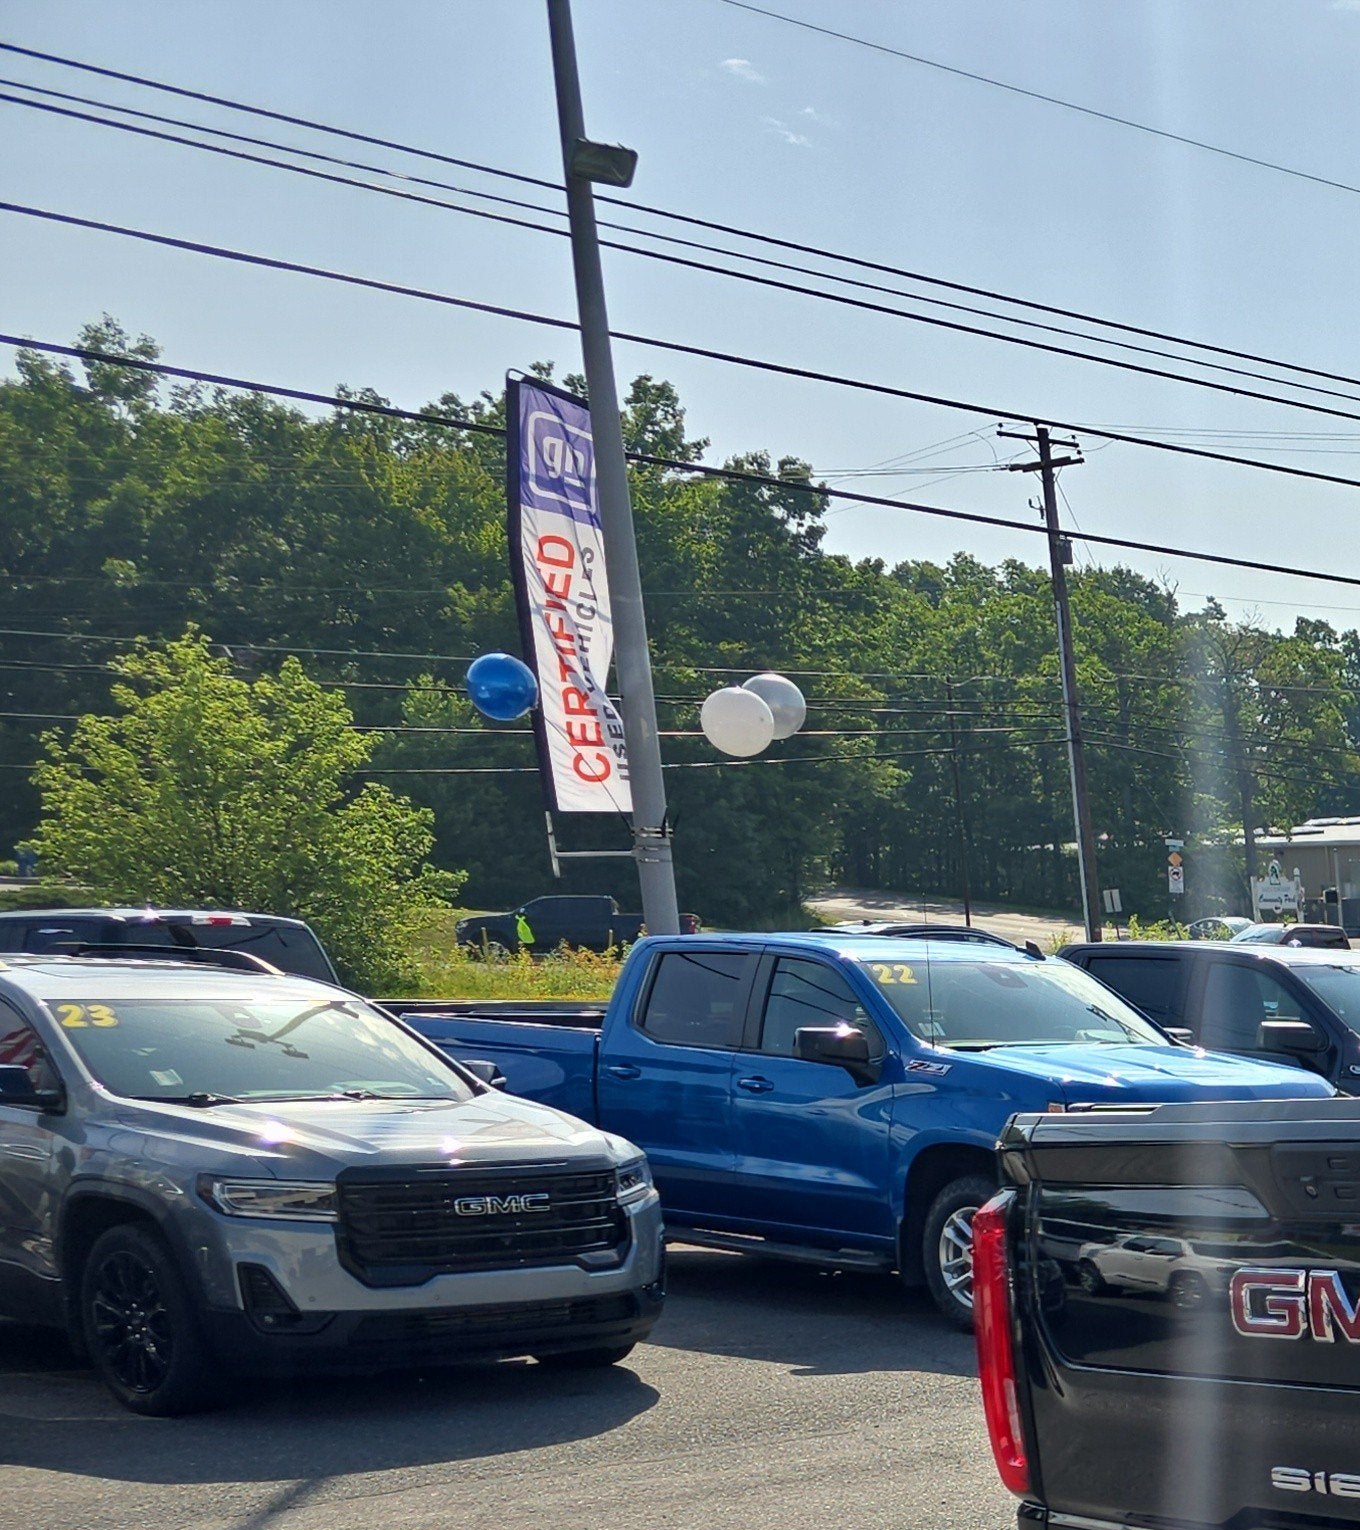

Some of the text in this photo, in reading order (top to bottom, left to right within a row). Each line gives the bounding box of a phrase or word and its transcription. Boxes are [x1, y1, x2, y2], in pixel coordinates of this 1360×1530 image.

[536, 534, 611, 784] CERTIFIED
[872, 963, 918, 984] 22
[57, 1004, 118, 1028] 23
[454, 1193, 551, 1216] GMC
